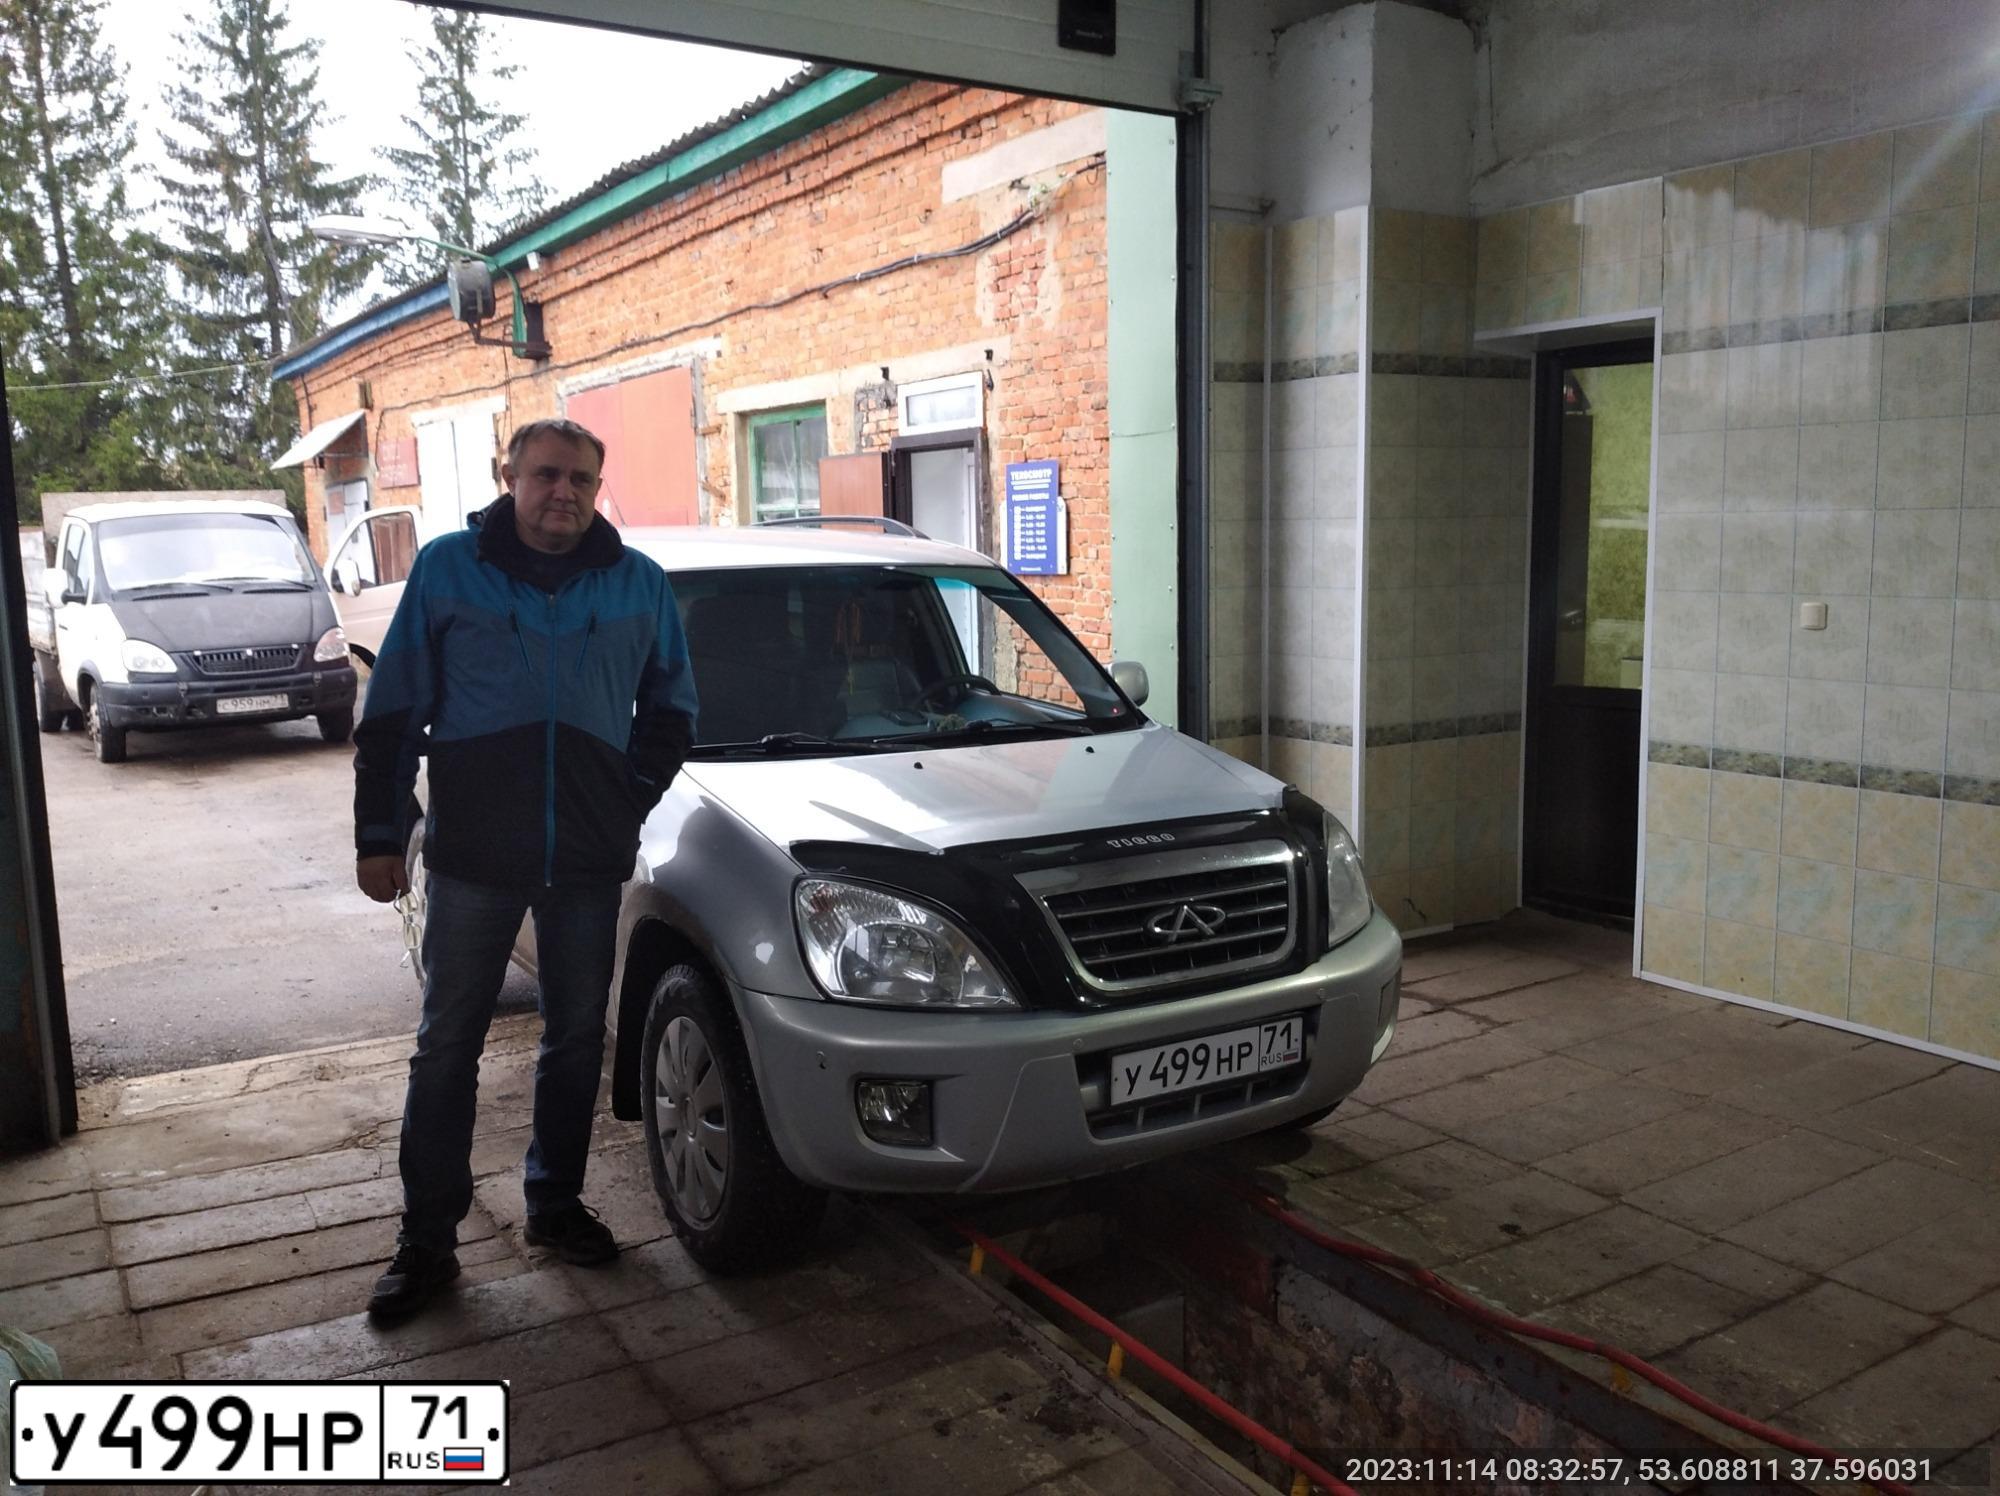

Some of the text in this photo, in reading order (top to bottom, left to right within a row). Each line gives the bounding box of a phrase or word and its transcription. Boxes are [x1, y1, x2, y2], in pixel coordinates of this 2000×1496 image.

[1125, 1022, 1292, 1096] У499НР 71
[1260, 1053, 1282, 1066] RUS
